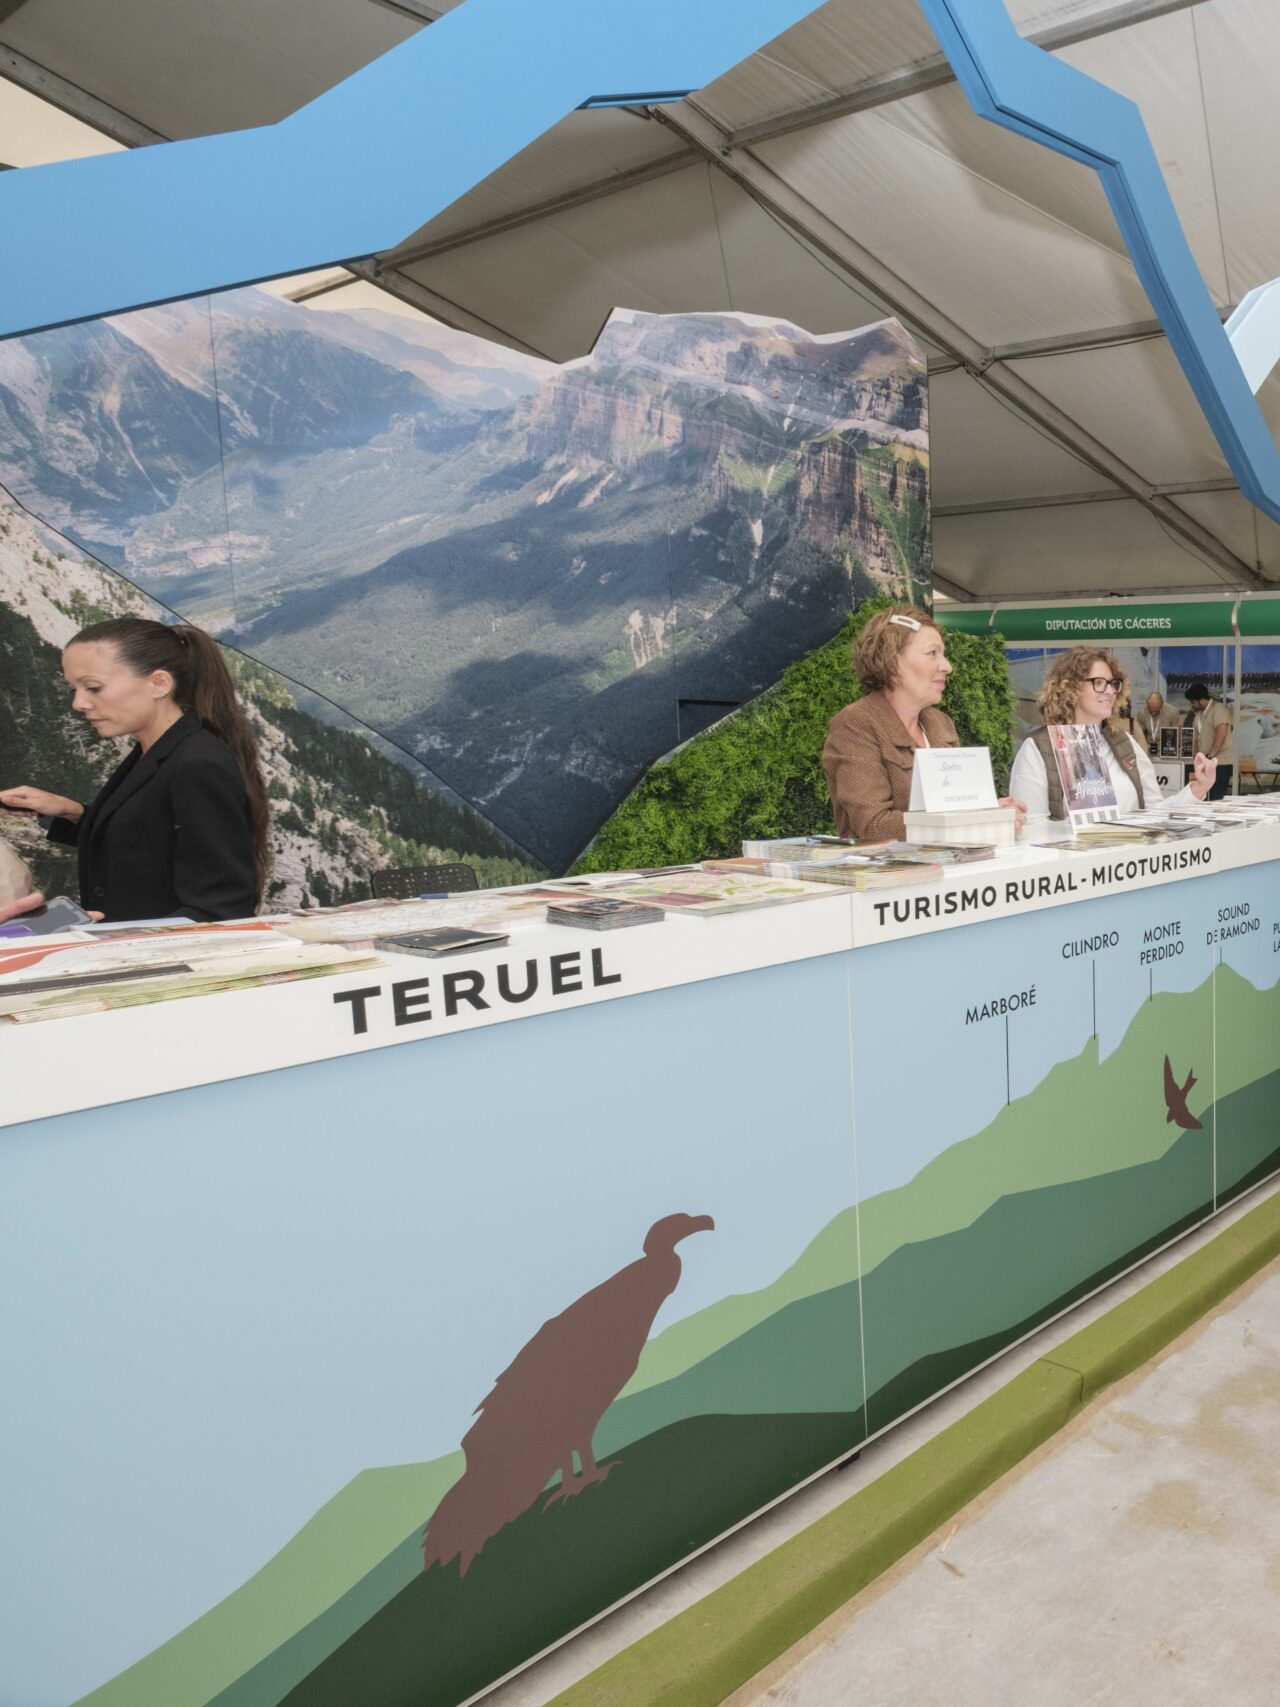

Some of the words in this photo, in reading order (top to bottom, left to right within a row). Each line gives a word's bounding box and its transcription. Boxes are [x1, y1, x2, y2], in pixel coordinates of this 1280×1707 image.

[1045, 617, 1107, 631] DIPUTACIÓN
[1109, 618, 1123, 630] DE
[1124, 616, 1172, 629] CÁCERES
[874, 884, 997, 927] TURISMO
[1004, 873, 1078, 903] RURAL
[1091, 846, 1212, 887] MICOTURISMO
[1217, 903, 1250, 922] SOUND
[1143, 921, 1181, 944] MONTE
[1220, 918, 1260, 940] RAMOND
[1062, 931, 1120, 959] CILINDRO
[1140, 940, 1184, 966] PERDIDO
[333, 948, 622, 1035] TERUEL
[965, 984, 1036, 1025] MARBORÉ
